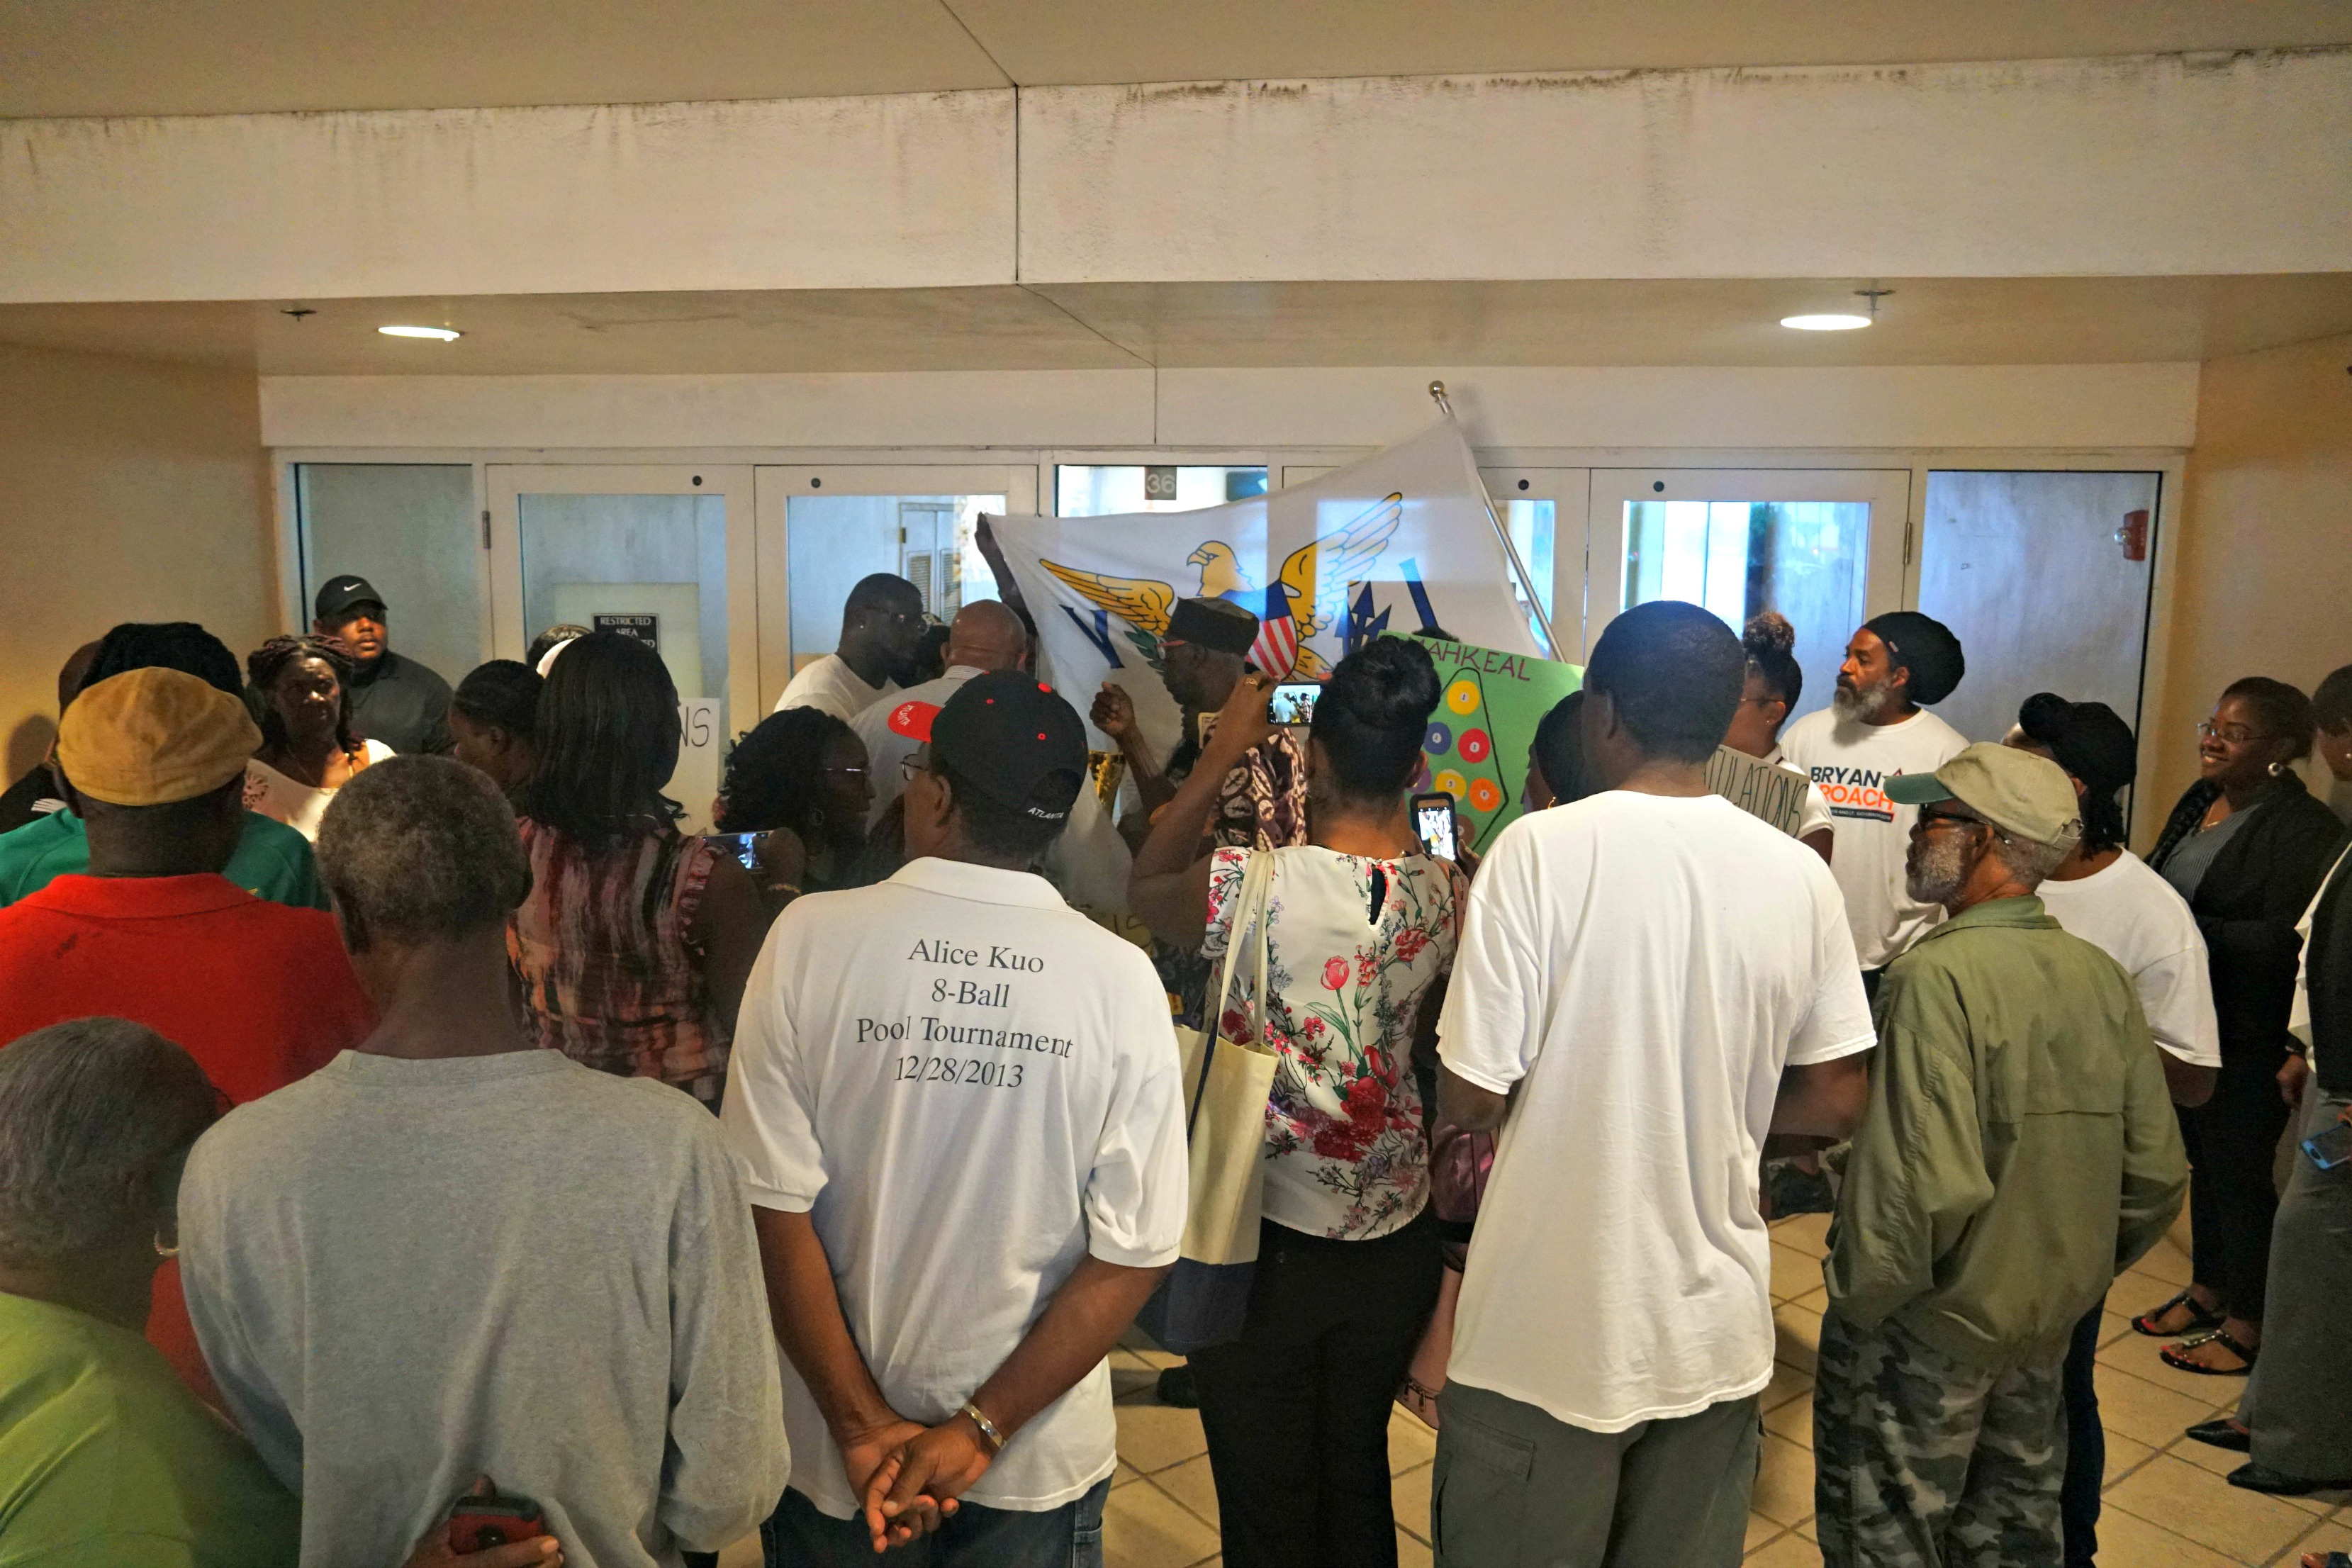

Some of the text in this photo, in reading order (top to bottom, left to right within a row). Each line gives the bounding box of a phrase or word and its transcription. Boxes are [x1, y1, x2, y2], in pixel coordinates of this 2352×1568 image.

[1146, 474, 1176, 494] 36
[600, 616, 652, 625] RESTRICTED
[615, 627, 639, 637] AREA
[1058, 604, 1126, 669] V
[1415, 637, 1530, 681] AHKEAL
[1810, 766, 1882, 788] BRYAN
[1819, 784, 1894, 810] ROACH
[1027, 807, 1065, 819] ATLANTA
[907, 938, 1044, 973] Alice Kuo
[931, 978, 1009, 1008] 8-Ball
[856, 1016, 1074, 1058] Pool Tournament
[894, 1055, 1024, 1088] 12/28/2013
